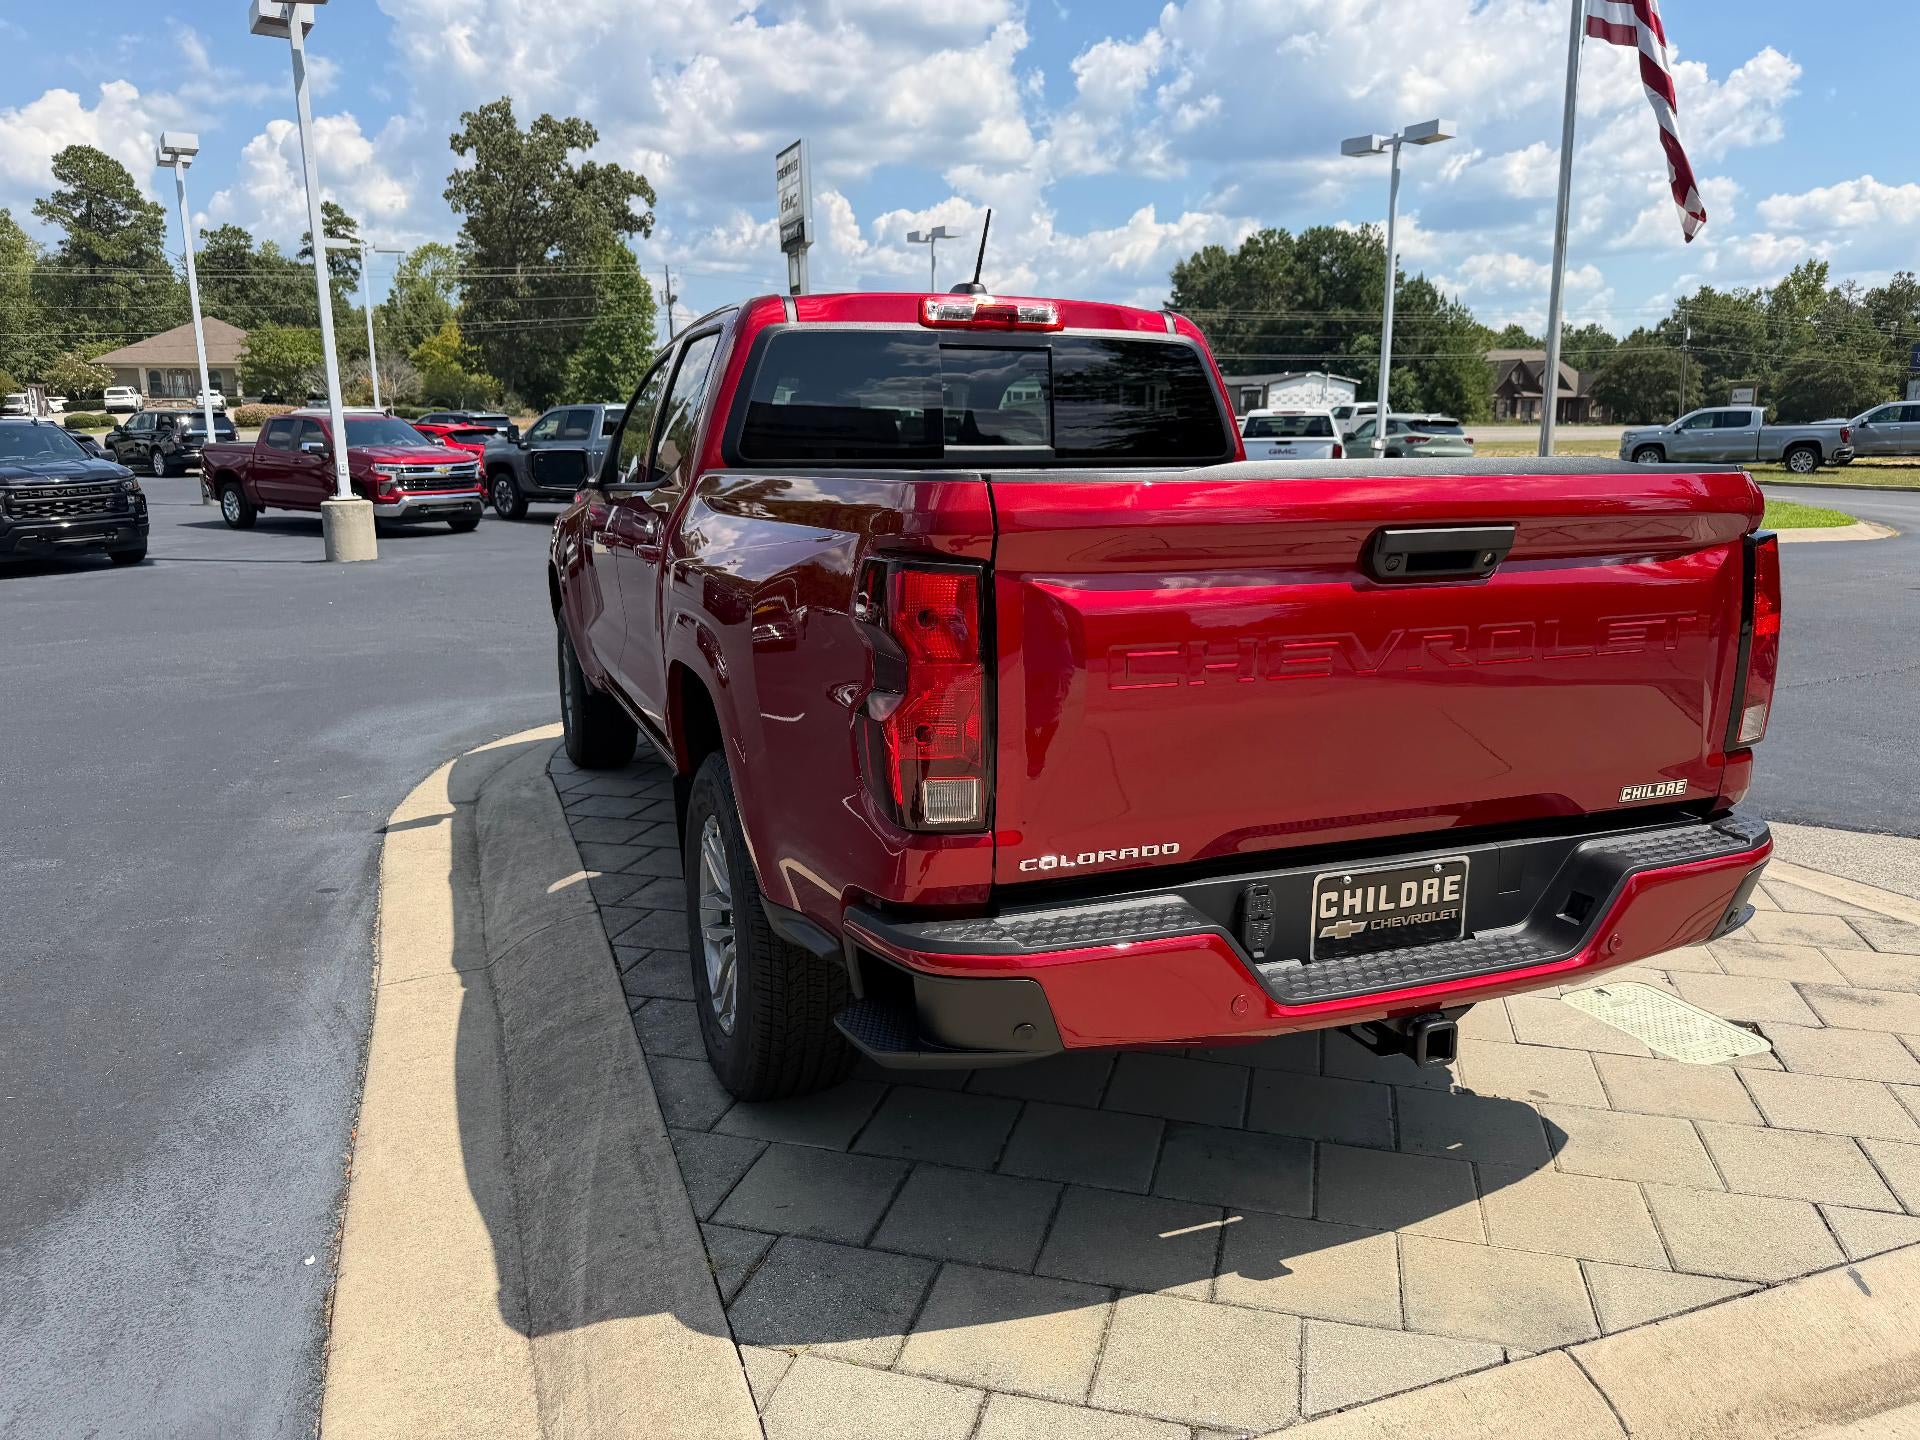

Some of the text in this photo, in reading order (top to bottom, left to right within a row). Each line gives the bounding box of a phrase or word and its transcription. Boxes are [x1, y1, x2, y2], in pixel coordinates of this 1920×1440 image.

[1268, 447, 1298, 455] GMC
[1107, 609, 1698, 691] CHEVROLET
[1621, 781, 1686, 801] CHILDRE
[1018, 842, 1180, 872] COLORADO
[1319, 874, 1462, 919] CHILDRE
[1370, 908, 1459, 931] CHEVROLET
